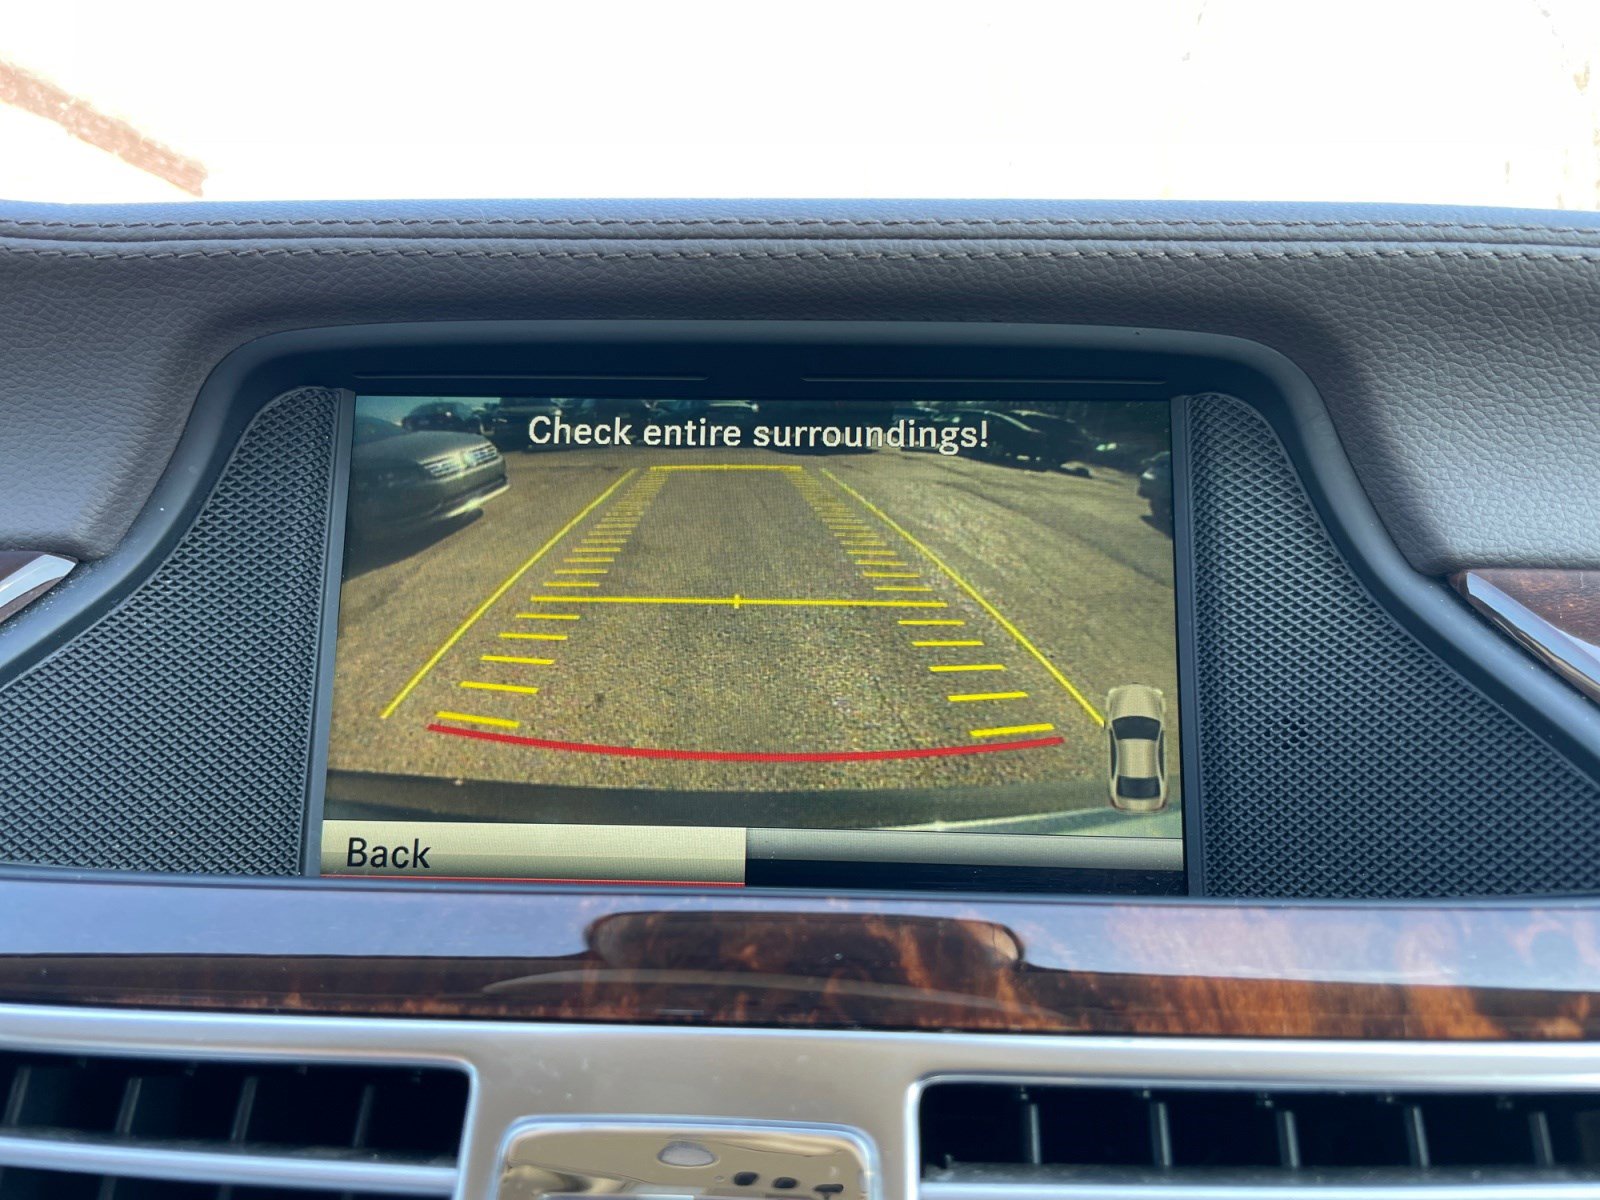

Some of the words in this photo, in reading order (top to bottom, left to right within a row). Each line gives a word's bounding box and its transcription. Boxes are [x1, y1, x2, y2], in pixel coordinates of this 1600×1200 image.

[528, 416, 633, 446] Check
[643, 418, 742, 447] entire
[753, 419, 989, 456] surroundings!
[346, 837, 431, 869] Back
